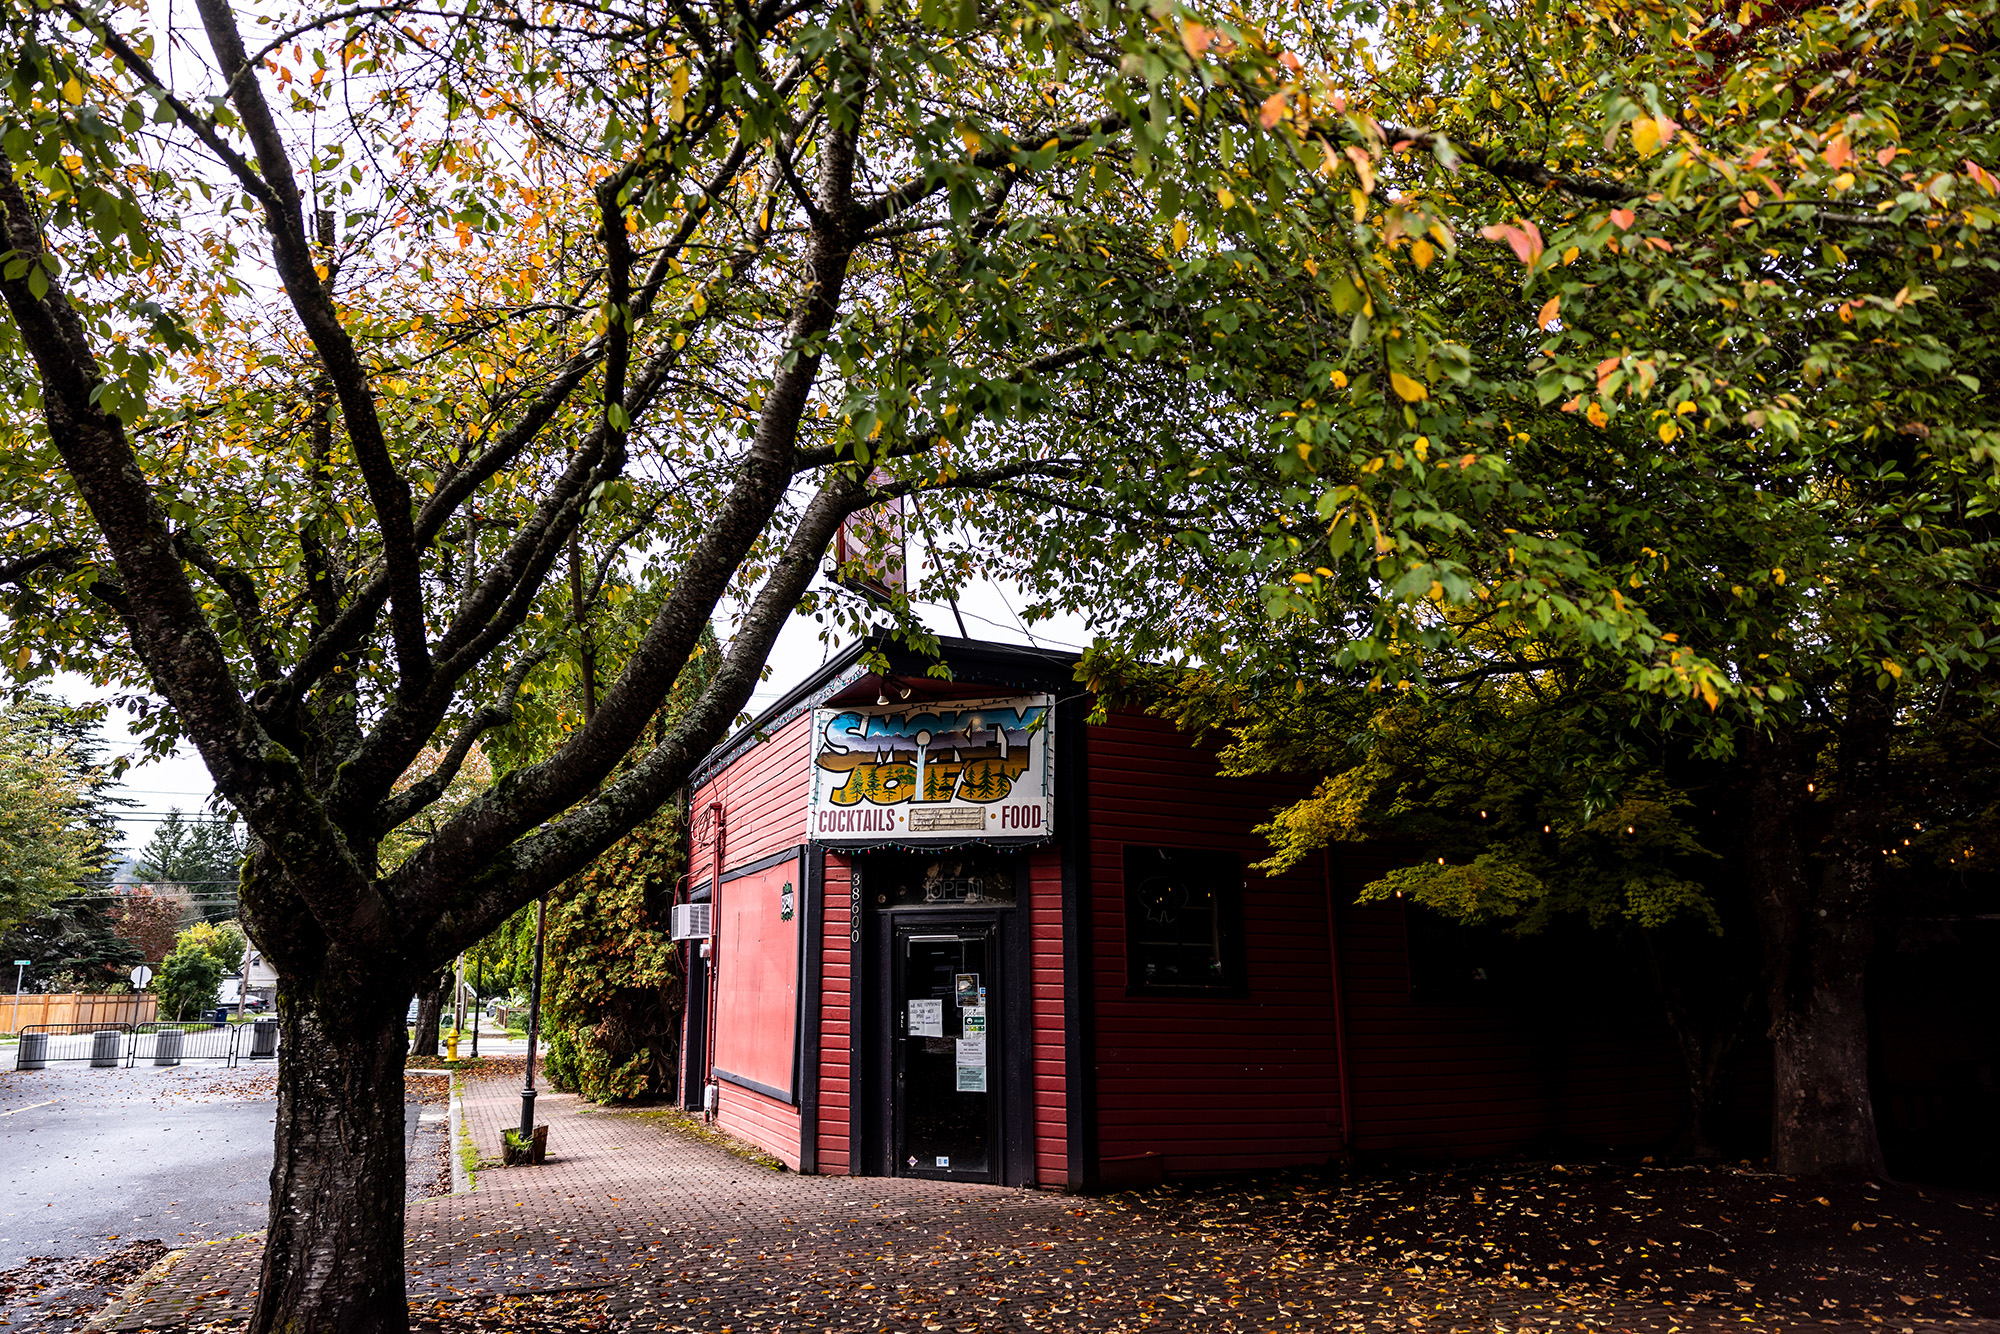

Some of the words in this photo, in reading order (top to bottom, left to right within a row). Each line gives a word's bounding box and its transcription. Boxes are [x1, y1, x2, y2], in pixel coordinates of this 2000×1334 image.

[814, 705, 1053, 773] SMOKEY
[819, 808, 896, 833] COCKTAILS
[1001, 804, 1042, 829] FOOD
[851, 872, 861, 943] 38600
[930, 881, 979, 899] OPEN
